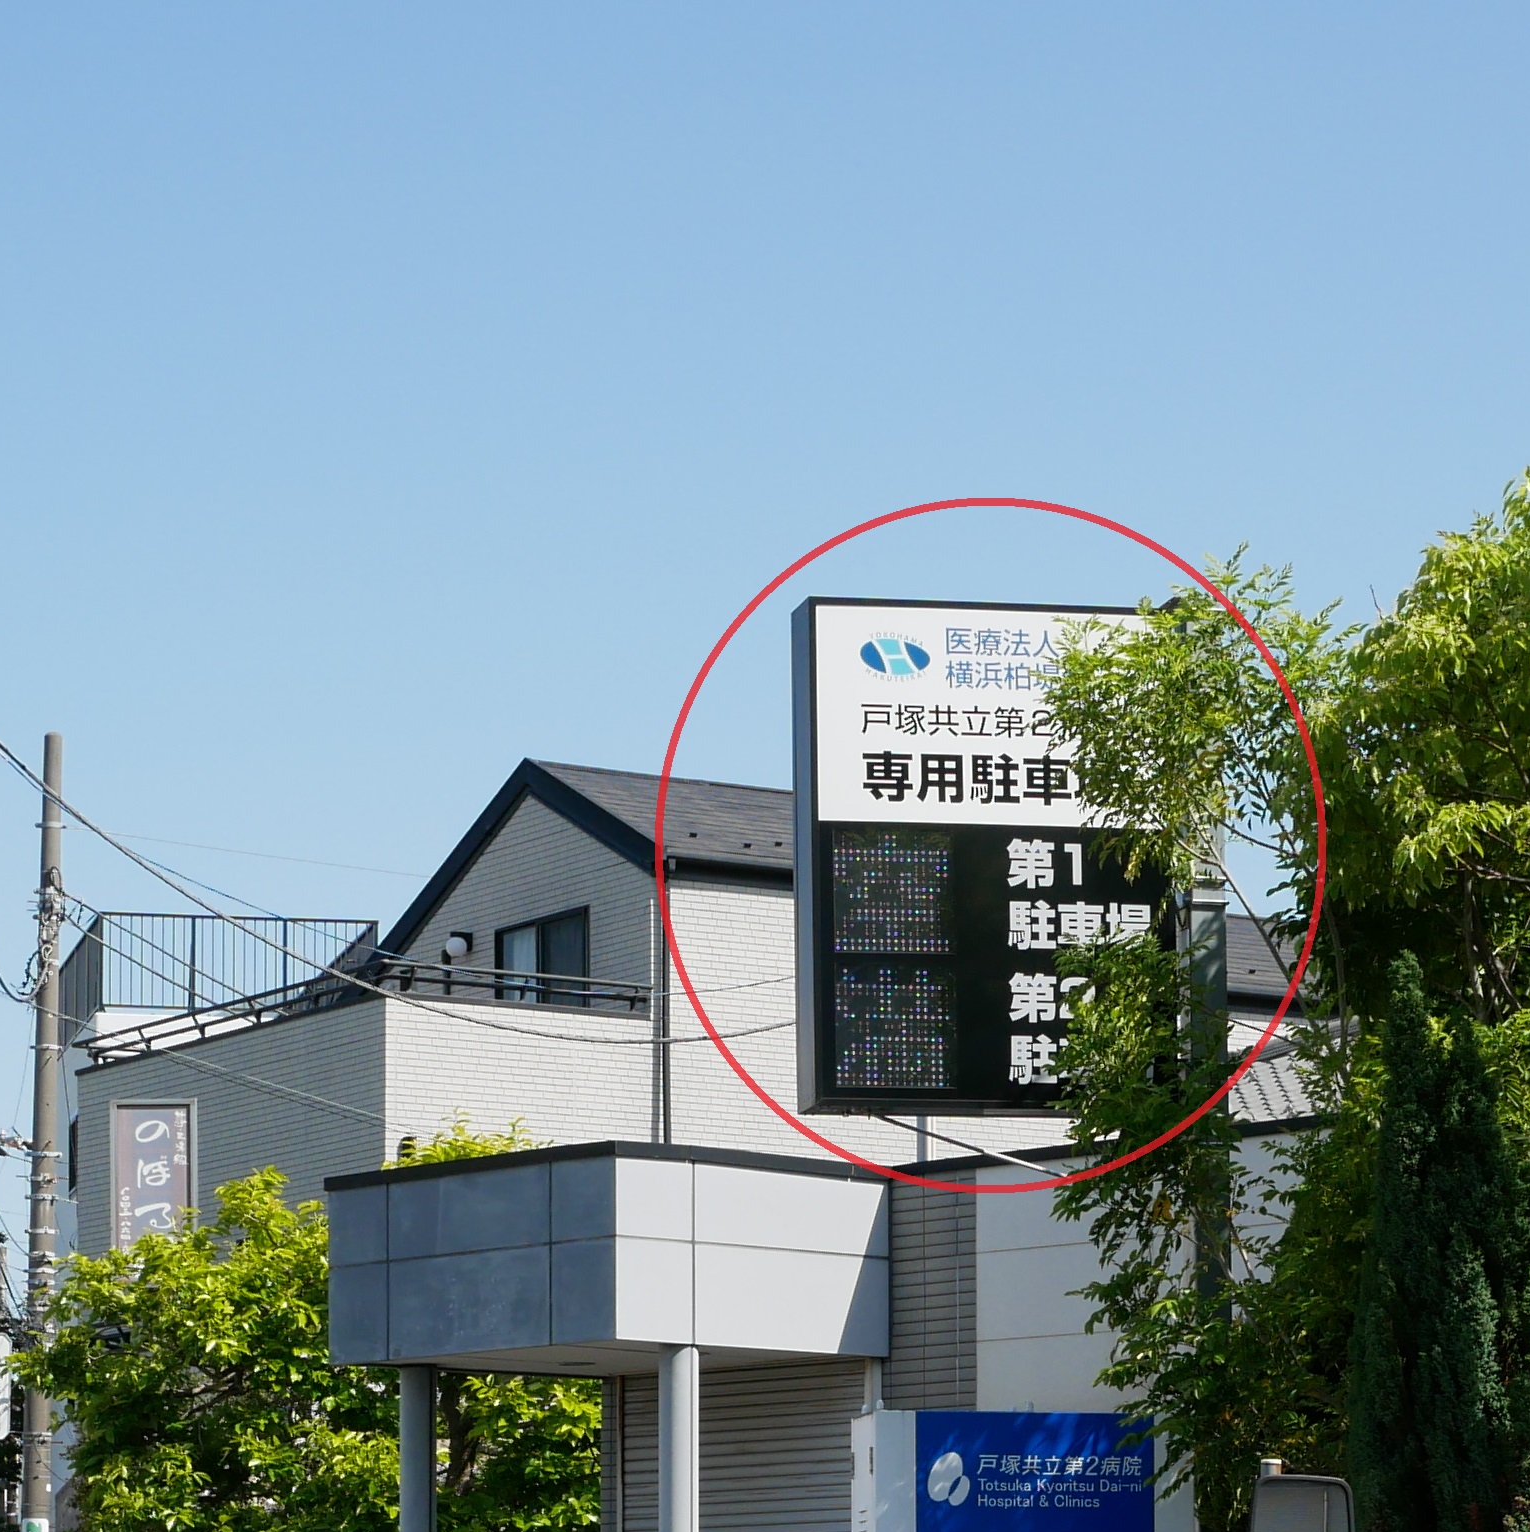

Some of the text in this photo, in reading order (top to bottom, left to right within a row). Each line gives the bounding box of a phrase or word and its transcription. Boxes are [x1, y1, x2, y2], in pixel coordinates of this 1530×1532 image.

[945, 627, 1059, 657] 医療法人
[861, 703, 1055, 738] 戸塚共立第2
[862, 750, 1081, 806] 専用駐車
[1007, 838, 1083, 889] 第1
[1008, 899, 1151, 951] 駐車場
[977, 1454, 1142, 1476] 戸塚共立第2病院
[978, 1478, 1142, 1494] Totsuka Kyoritsu Dai-ni
[978, 1494, 1100, 1509] Hospital & Clinics
